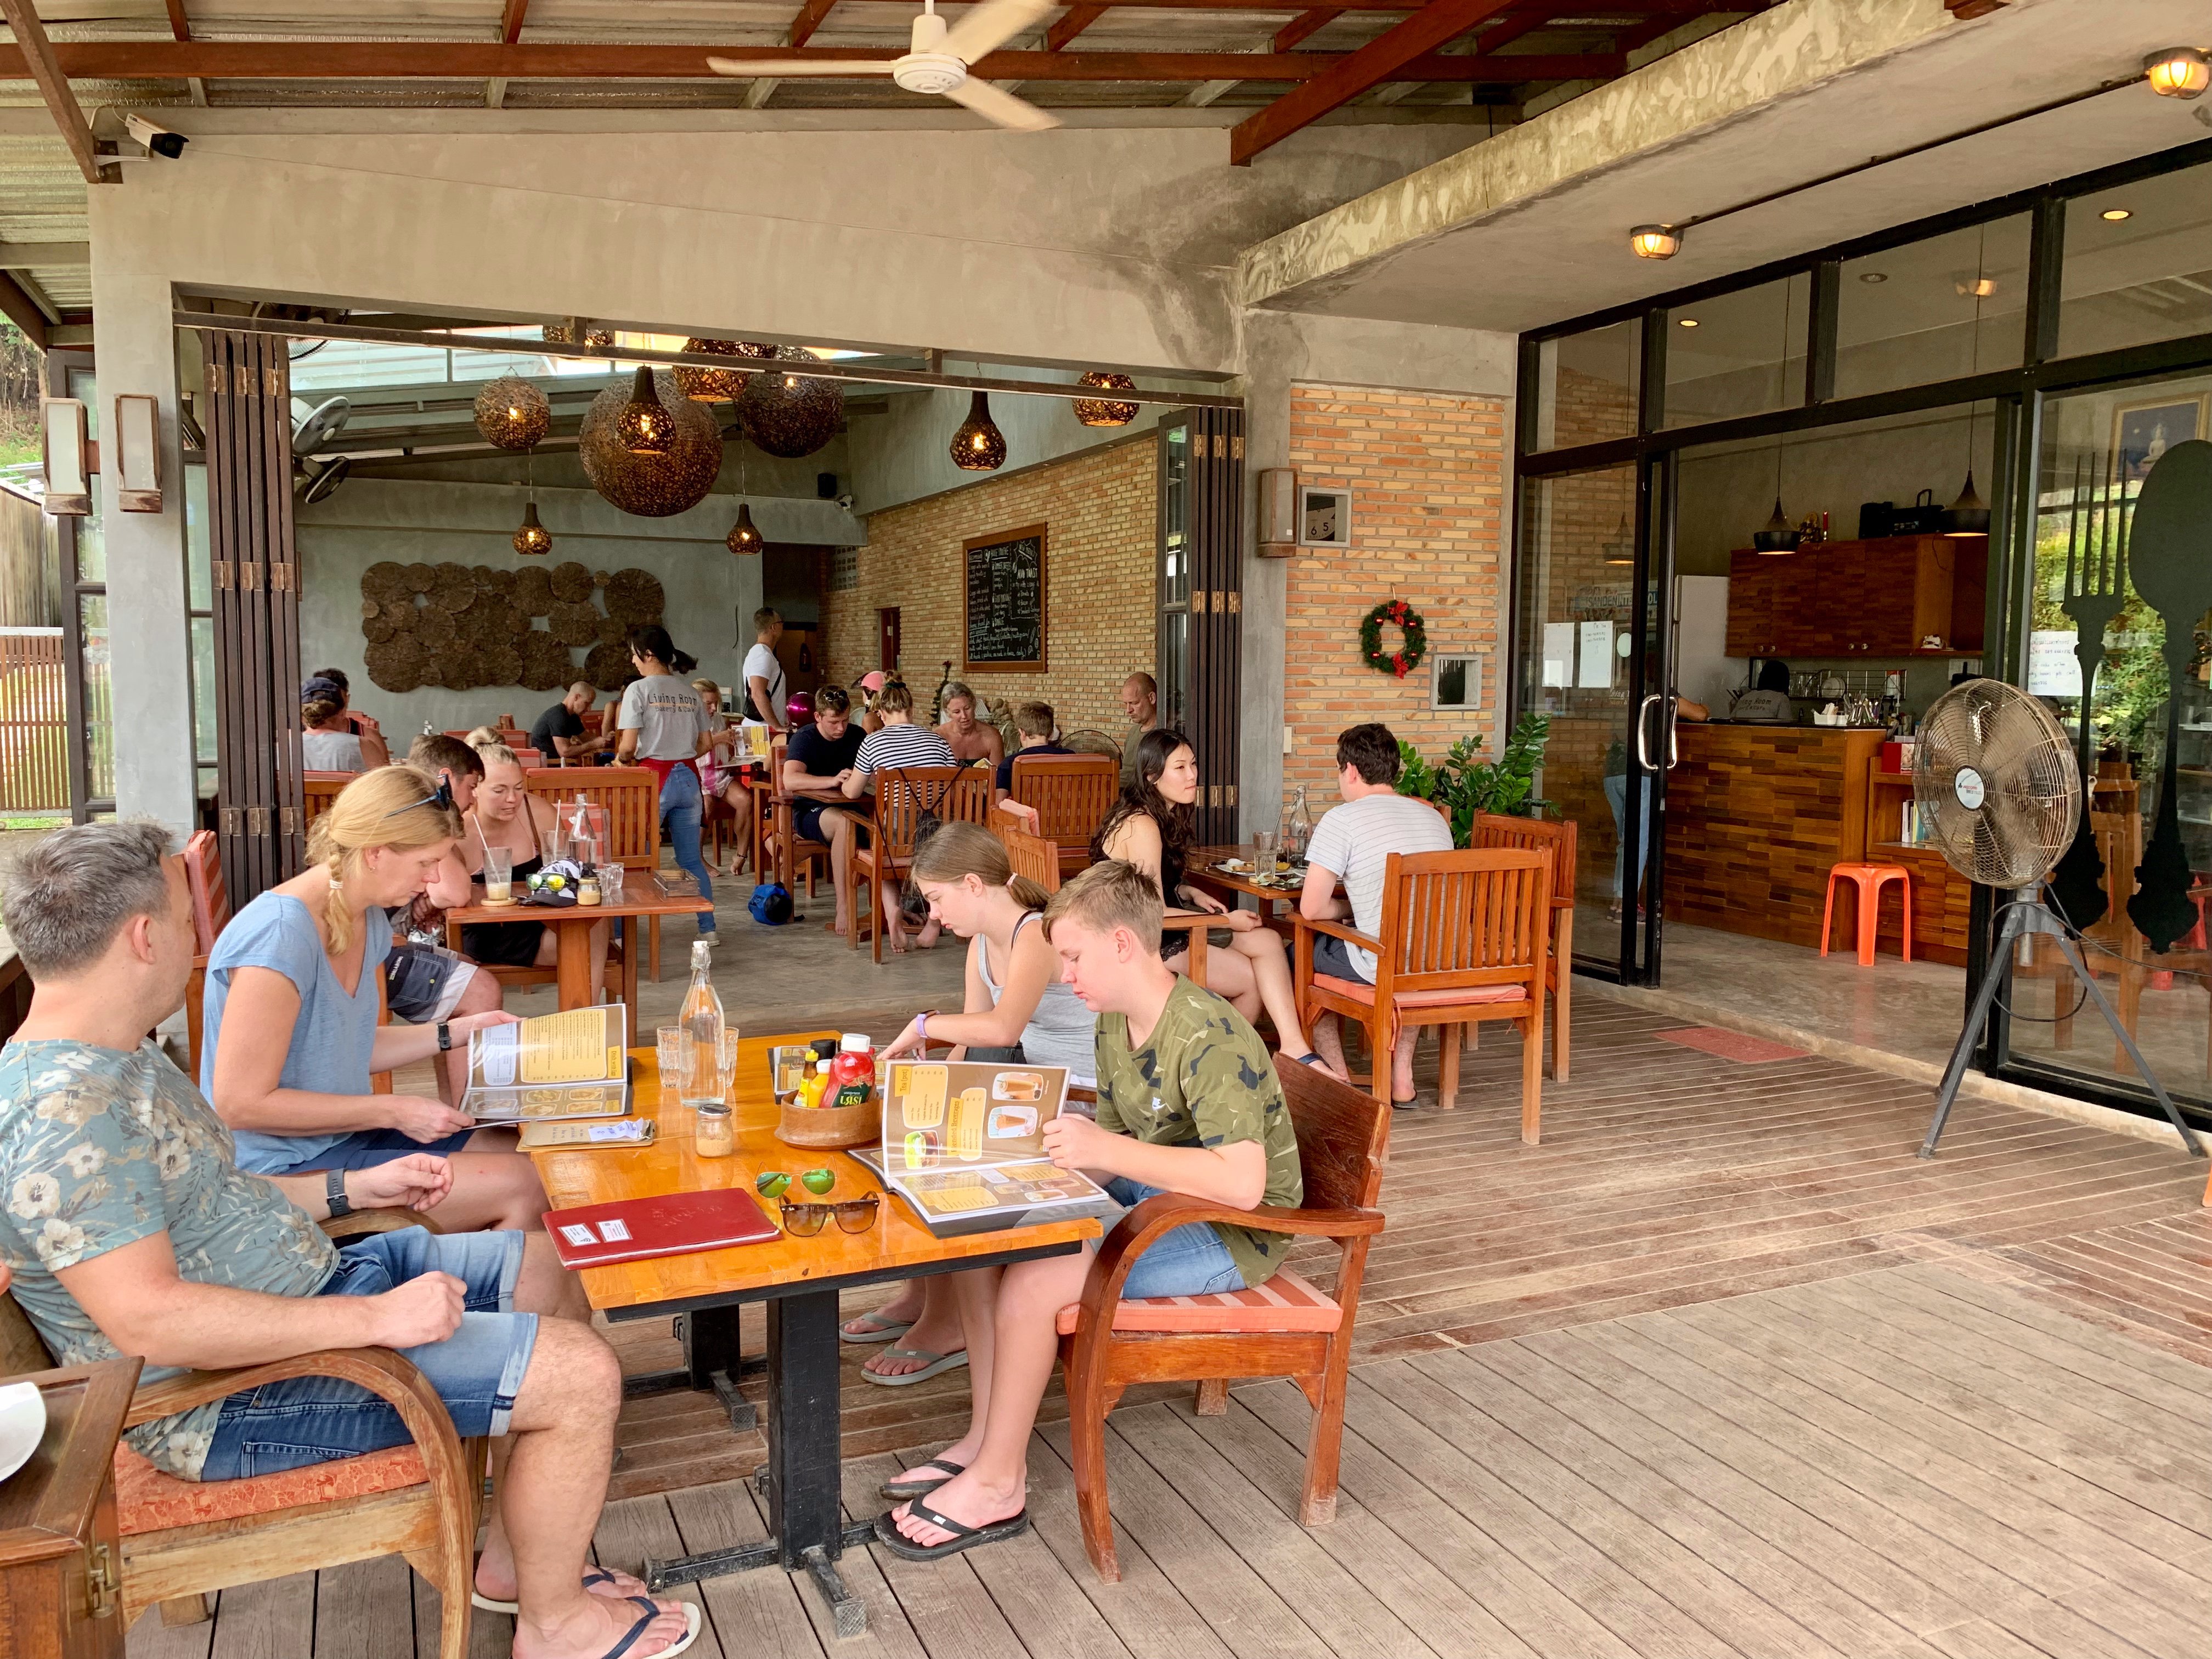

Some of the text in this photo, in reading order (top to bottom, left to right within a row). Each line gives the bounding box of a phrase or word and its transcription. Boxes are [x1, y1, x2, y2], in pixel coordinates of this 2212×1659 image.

[1588, 594, 1617, 607] SANDEN
[648, 693, 697, 707] Living Room
[900, 1069, 909, 1081] (pot)
[951, 1101, 960, 1126] Beverages
